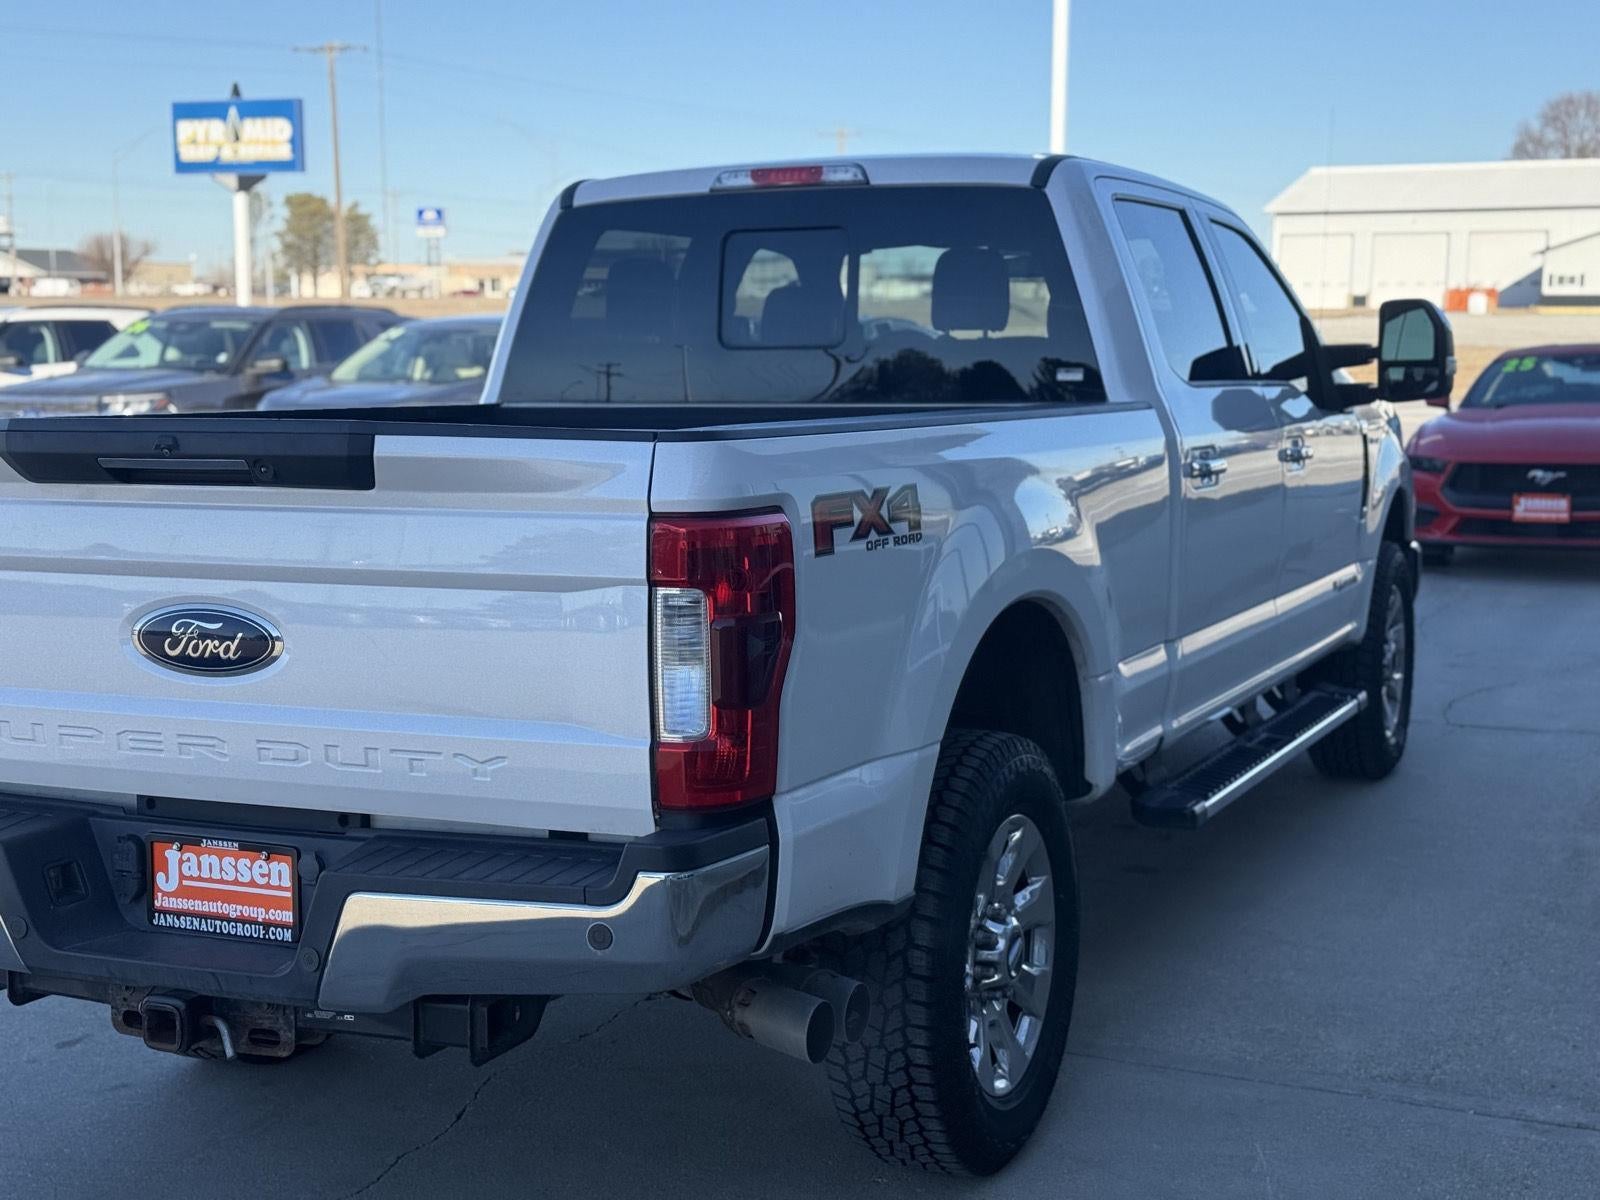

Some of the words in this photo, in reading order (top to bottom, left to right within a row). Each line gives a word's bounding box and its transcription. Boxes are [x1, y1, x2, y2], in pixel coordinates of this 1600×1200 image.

[810, 483, 922, 558] FX4
[866, 537, 889, 552] OFF
[893, 532, 923, 547] ROAD
[164, 618, 244, 661] Ford
[256, 738, 508, 781] DUTY
[200, 838, 240, 851] JANSSEN
[156, 850, 293, 892] Janssen
[154, 892, 294, 923] Janssenautogroup.com
